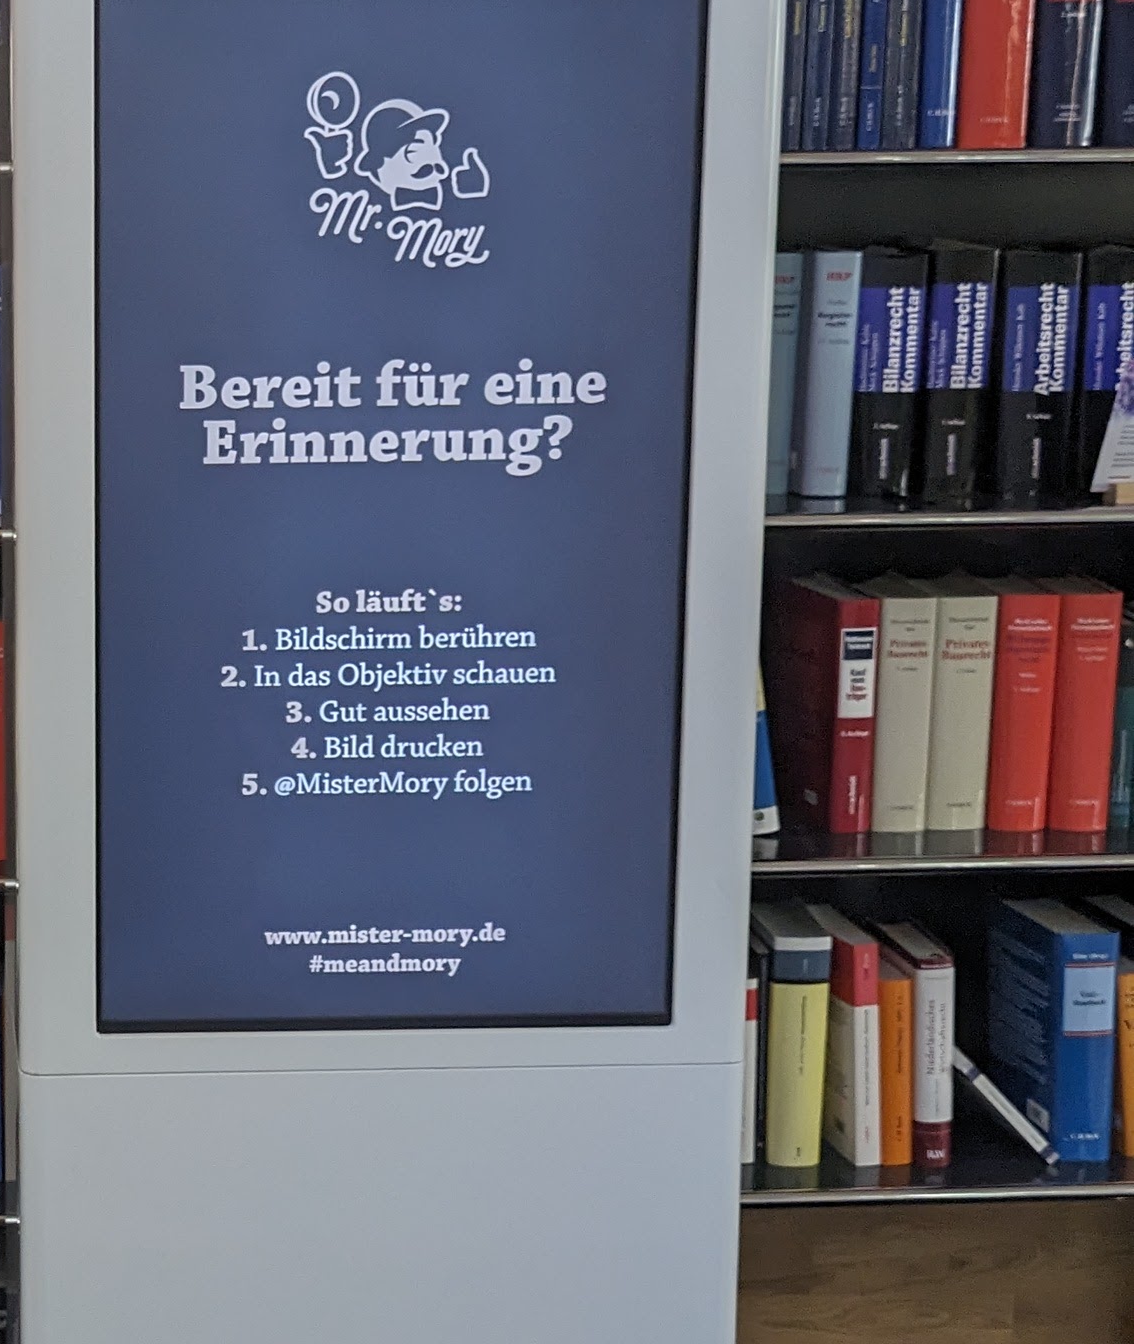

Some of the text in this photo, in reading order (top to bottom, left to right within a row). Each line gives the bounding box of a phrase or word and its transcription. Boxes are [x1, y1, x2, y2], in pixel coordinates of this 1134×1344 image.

[310, 188, 490, 268] Mr. Mory
[882, 286, 905, 394] Bilanzrecht
[900, 287, 921, 394] Kommentar
[949, 282, 974, 389] Bilanzrecht
[967, 282, 988, 389] Kommentar
[1033, 282, 1055, 396] Arbeitsrecht
[1048, 285, 1070, 394] Kommentar
[179, 358, 607, 410] Bereit für eine
[203, 414, 573, 477] Erinnerung?
[316, 591, 350, 614] So
[242, 624, 536, 651] 1. Bildschirm berühren
[221, 659, 556, 692] 2. In das Objektiv schauen
[286, 697, 490, 724] 3. Gut aussehen
[290, 733, 483, 759] 4. Bild drucken
[242, 768, 533, 800] 5. @MisterMory folgen
[264, 922, 506, 947] www.mister-mory.de
[309, 953, 461, 977] #meandmory
